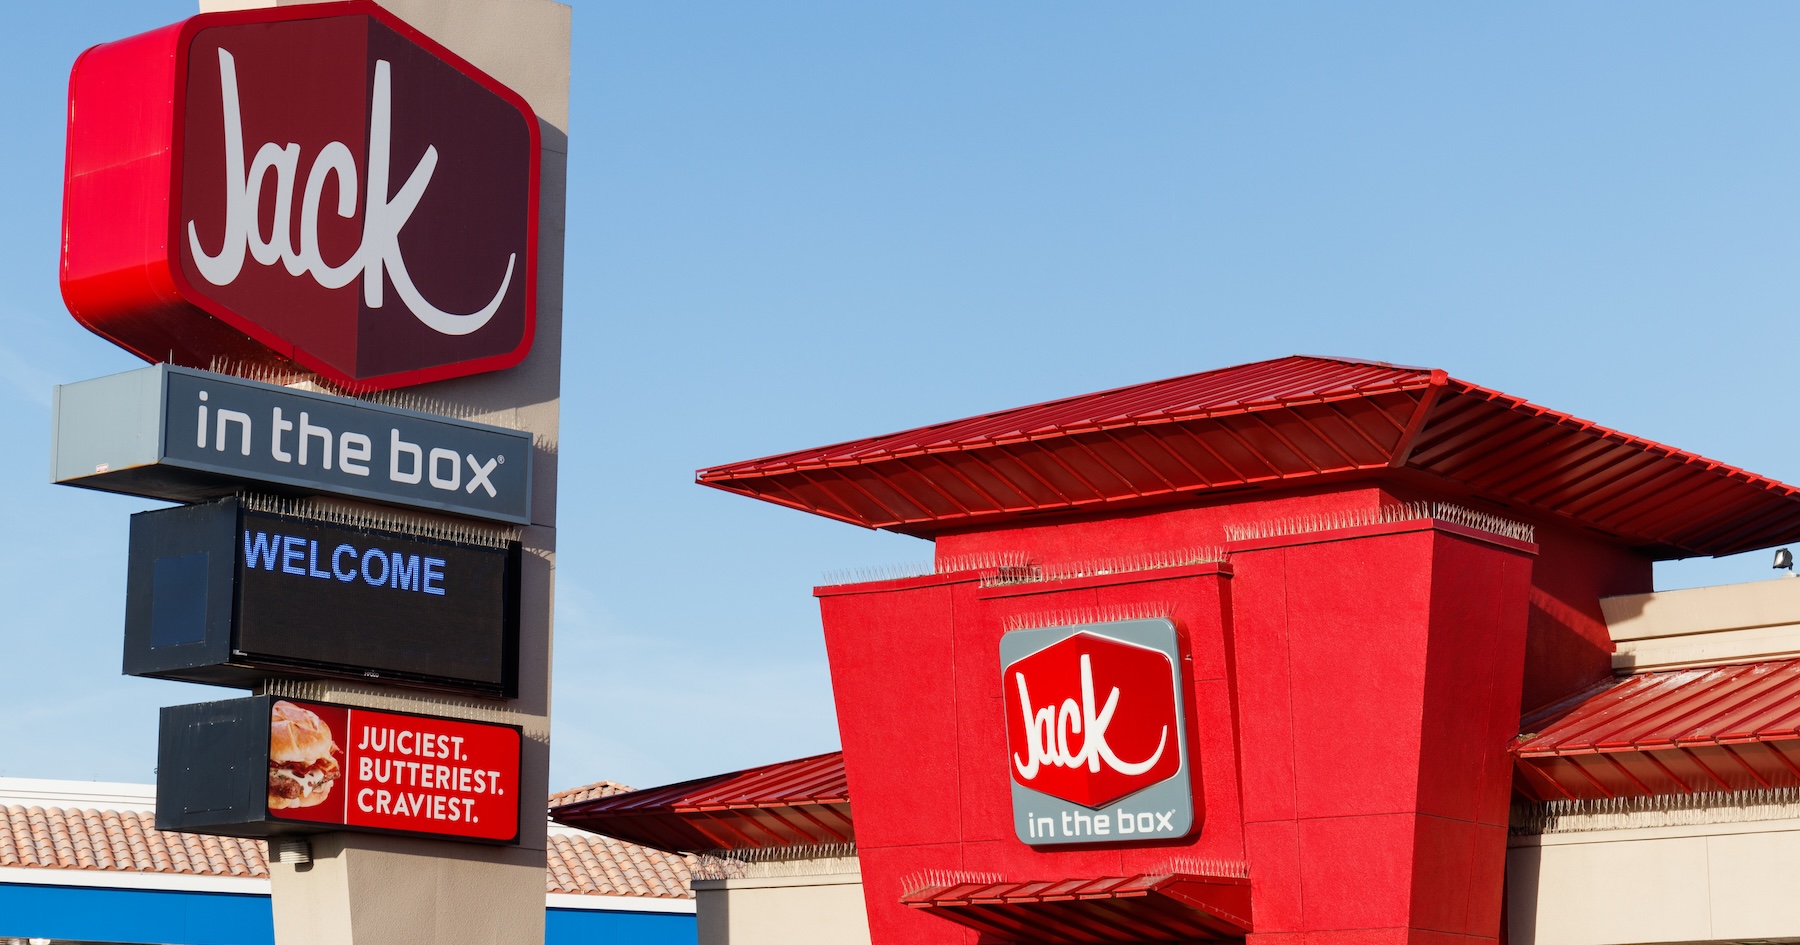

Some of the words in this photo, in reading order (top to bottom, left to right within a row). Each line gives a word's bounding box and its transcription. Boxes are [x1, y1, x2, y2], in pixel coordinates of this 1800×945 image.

[188, 47, 516, 335] Jack
[197, 391, 252, 456] in
[272, 407, 372, 477] the
[244, 530, 446, 595] WELCOME
[1014, 654, 1168, 780] Jack
[358, 726, 468, 761] JUICIEST.
[359, 757, 504, 795] BUTTERIEST.
[357, 788, 479, 823] CRAVIEST.
[1028, 812, 1055, 838] in
[1061, 810, 1110, 836] the
